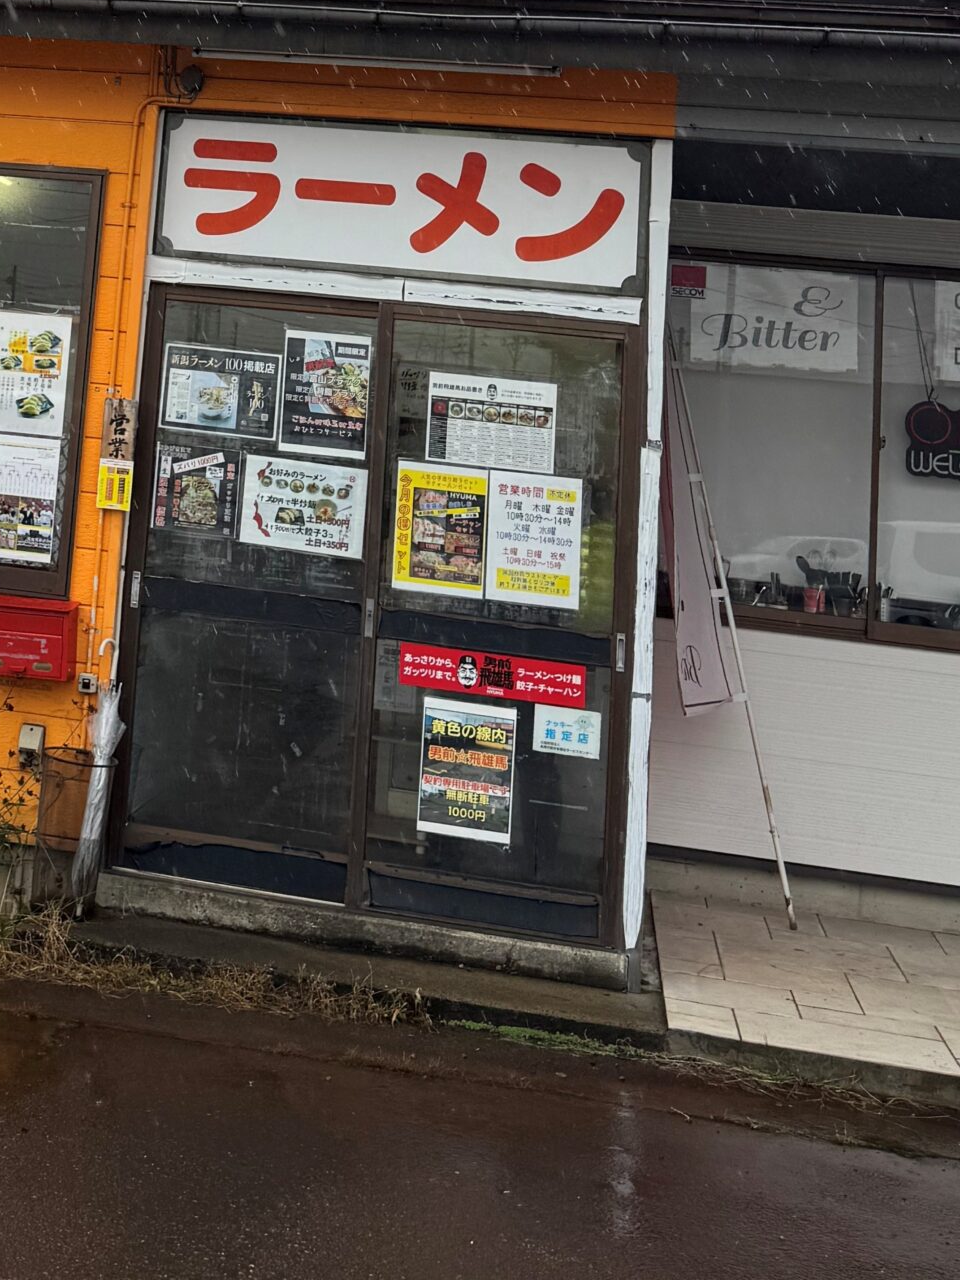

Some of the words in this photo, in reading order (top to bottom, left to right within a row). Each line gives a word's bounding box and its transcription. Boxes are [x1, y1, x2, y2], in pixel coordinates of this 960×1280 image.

[184, 138, 625, 262] ラーメン
[672, 288, 704, 297] SECOM
[701, 313, 840, 351] Bitter
[498, 483, 544, 499] 営業時間
[504, 500, 523, 511] 月曜
[533, 504, 551, 514] 木曜
[556, 505, 575, 516] 金曜
[514, 524, 530, 533] 火曜
[539, 526, 556, 536] 水曜
[502, 547, 518, 556] 土曜
[526, 550, 542, 559] 日曜
[404, 653, 456, 668] あっさりから、
[403, 666, 455, 682] ガッツリまで。
[432, 719, 506, 744] 黄色の線内
[545, 728, 589, 744] 指定店
[446, 789, 489, 805] 無断駐車
[448, 806, 485, 822] 1000円
